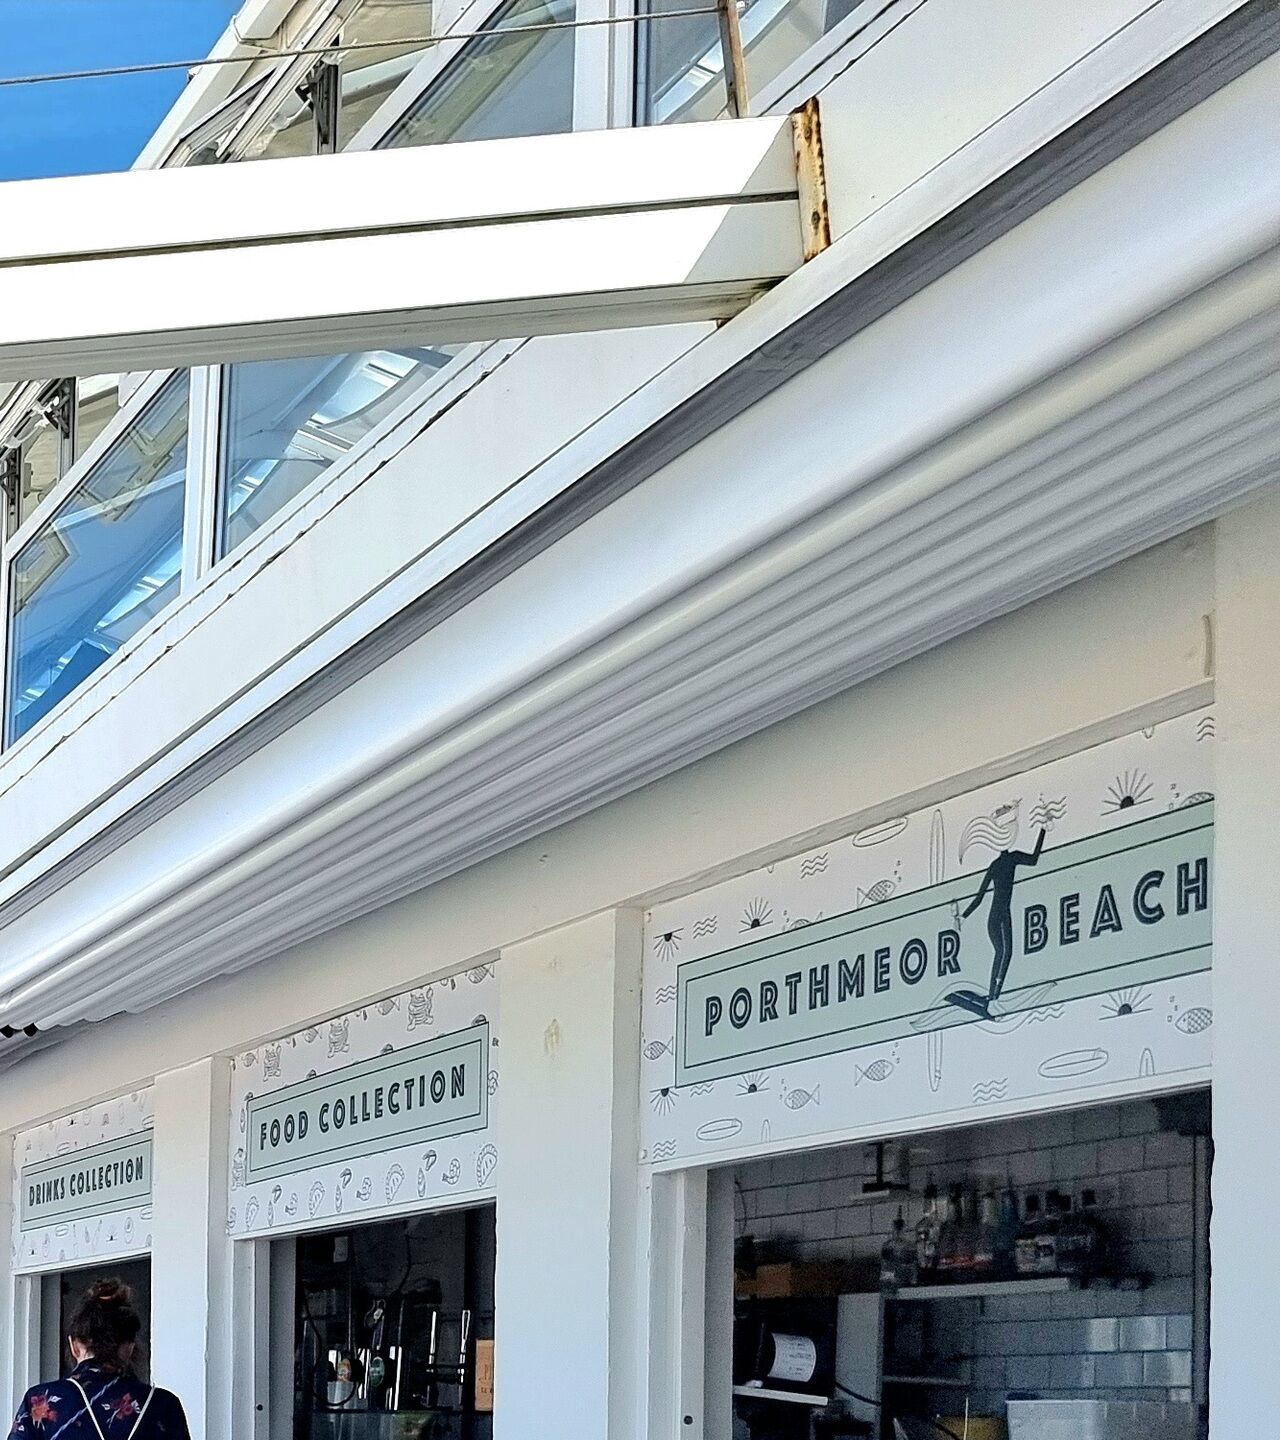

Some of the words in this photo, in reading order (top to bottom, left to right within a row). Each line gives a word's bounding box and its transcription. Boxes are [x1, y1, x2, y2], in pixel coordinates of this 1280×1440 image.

[704, 928, 961, 1037] PORTHMEOR
[1023, 857, 1208, 955] BEACH
[260, 1110, 309, 1150] FOOD
[318, 1063, 466, 1134] COLLECTION
[28, 1177, 66, 1207] DRINKS
[69, 1155, 144, 1197] COLLECTION
